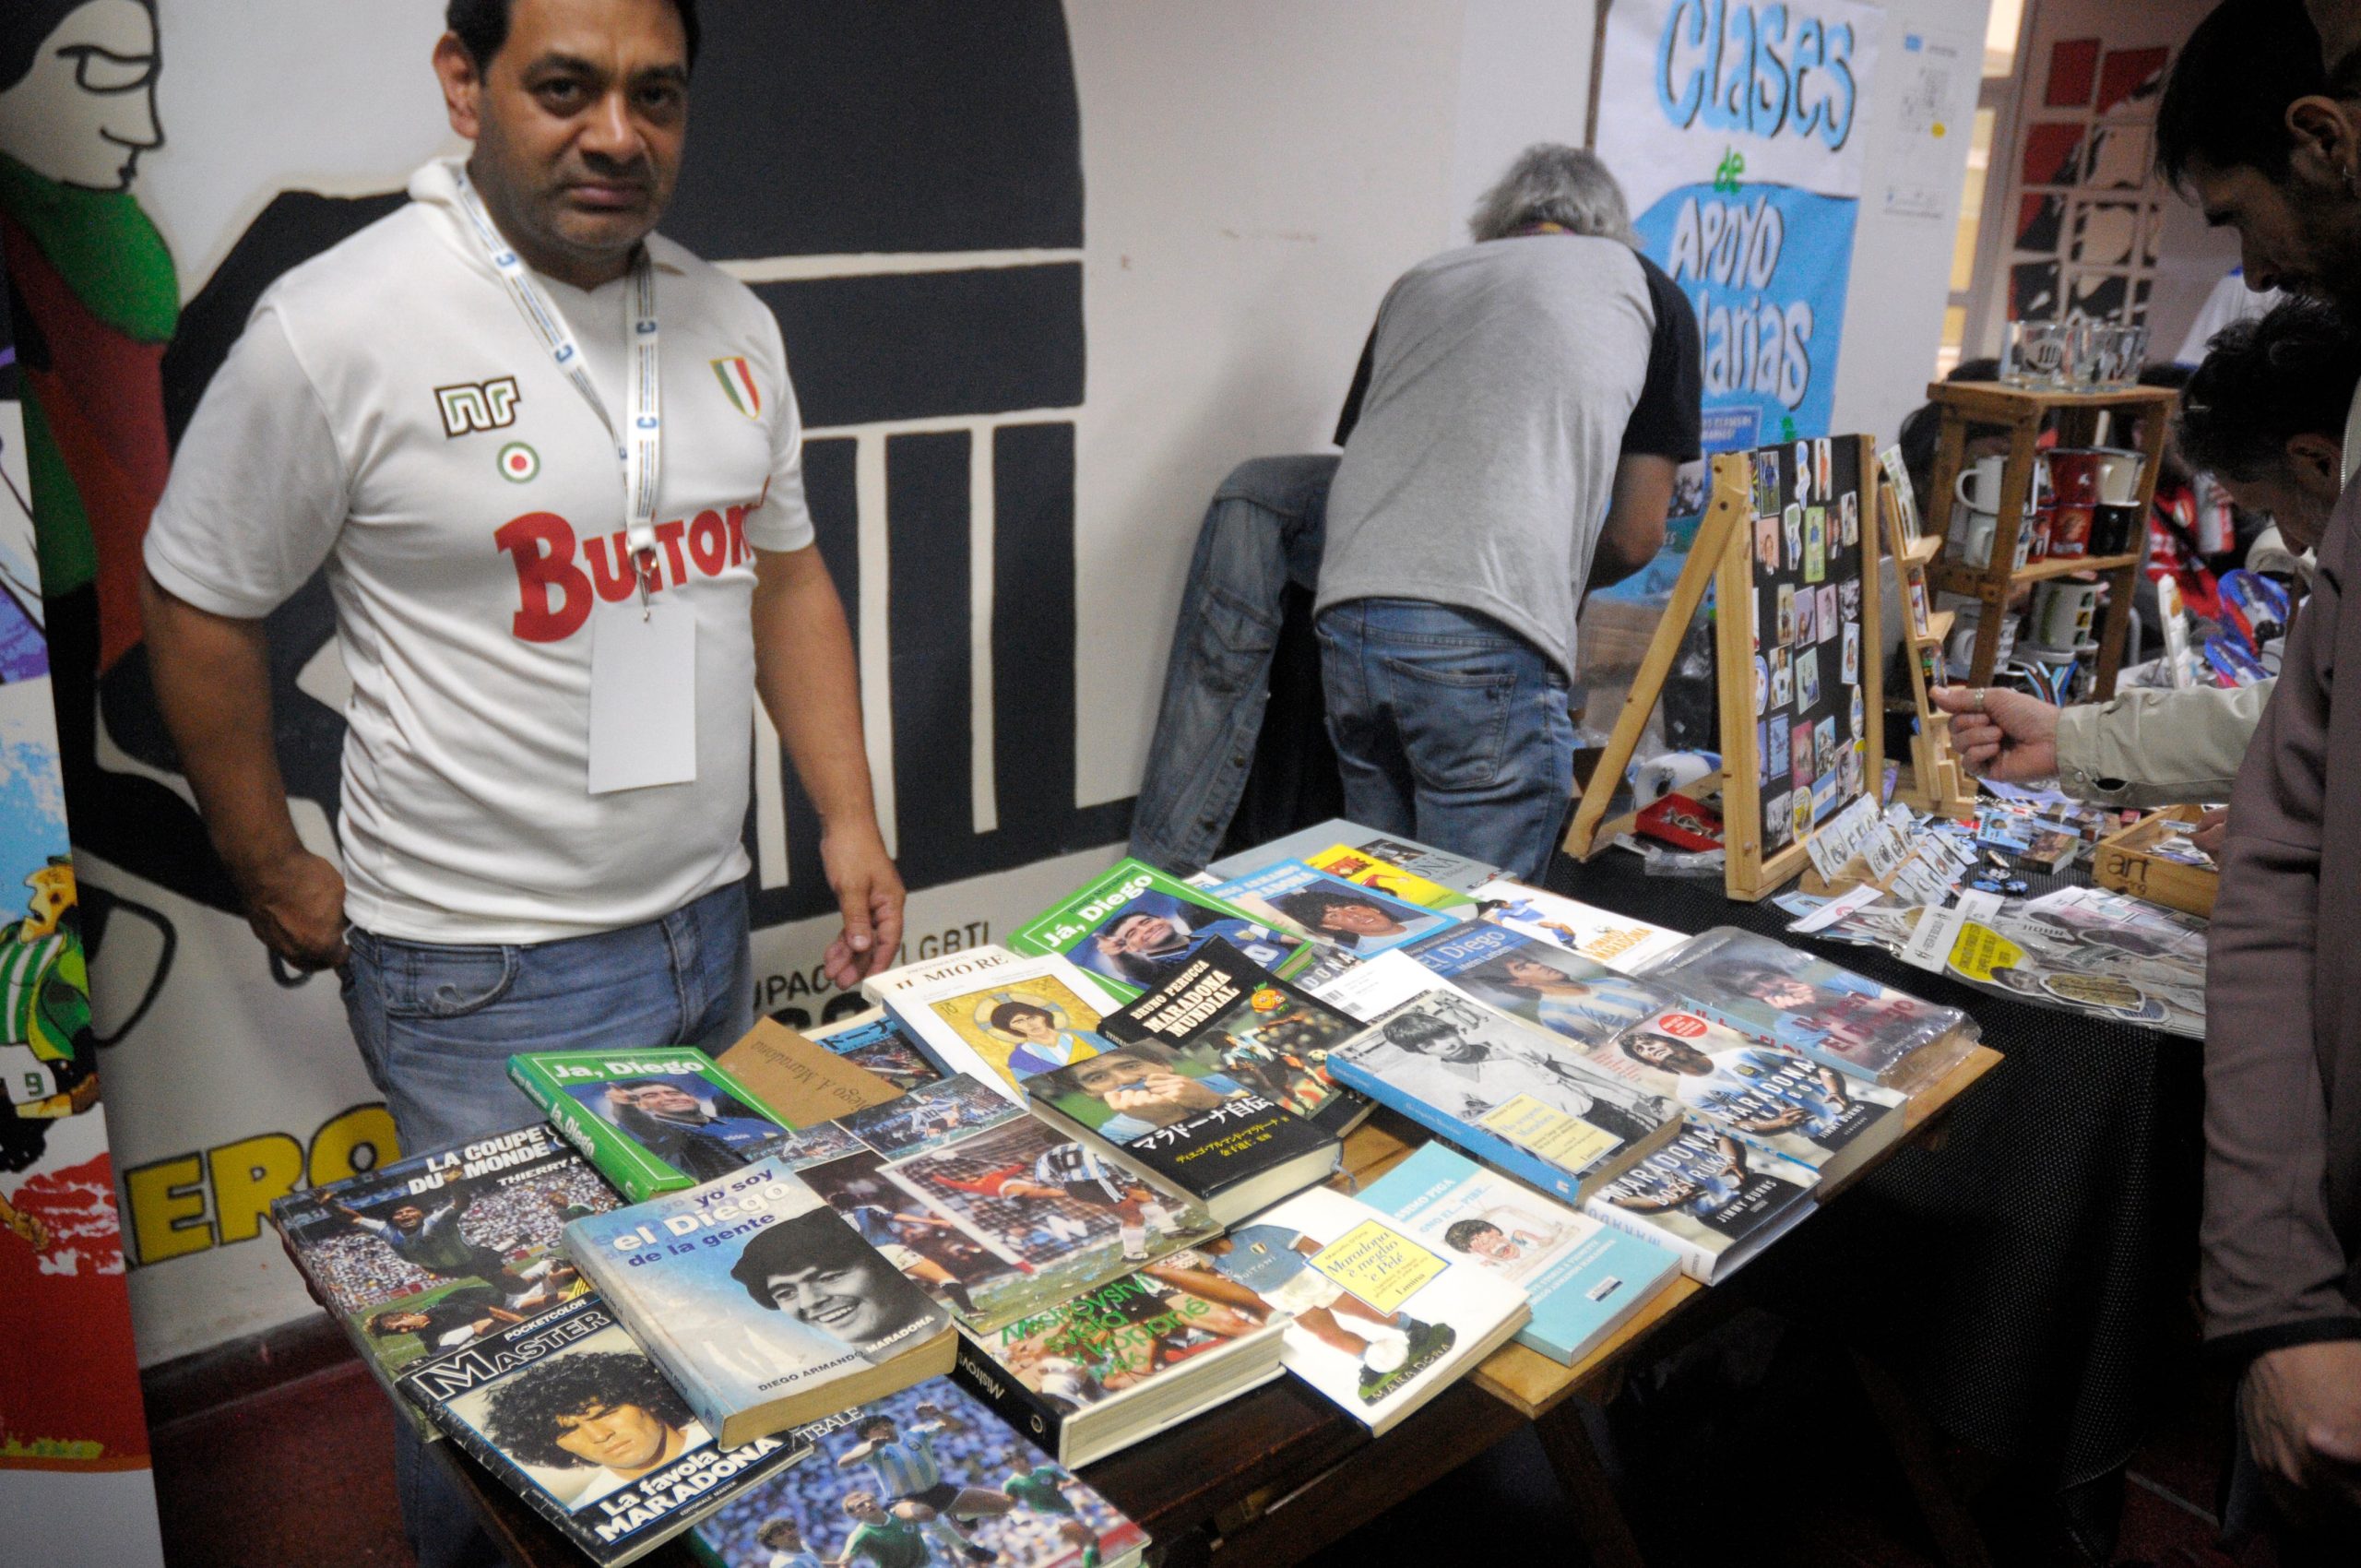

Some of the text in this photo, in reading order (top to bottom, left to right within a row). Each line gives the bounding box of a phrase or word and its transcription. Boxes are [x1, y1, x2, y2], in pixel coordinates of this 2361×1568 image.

[1655, 0, 1857, 153] Clases
[1713, 145, 1746, 196] de
[1667, 195, 1785, 293] APOYO
[1077, 874, 1153, 922] Diego
[923, 964, 973, 982] MIO
[975, 954, 1009, 970] RE
[1437, 931, 1506, 959] Diego
[1130, 959, 1211, 1020] BRUNO PERUCCA
[1143, 969, 1232, 1034] MARADONA
[1165, 984, 1241, 1038] MUNDIAL
[24, 1072, 44, 1097] 9
[604, 1060, 705, 1075] Diego
[1718, 1059, 1819, 1126] MARADONA
[1840, 1104, 1867, 1124] BURNS
[1132, 1095, 1275, 1150] マラドーナ自伝
[408, 1141, 552, 1195] DU MONDE
[425, 1152, 461, 1173] LA
[463, 1126, 545, 1161] COUPE
[496, 1158, 568, 1186] THIERRY
[1605, 1127, 1721, 1202] MARADONA
[1691, 1154, 1735, 1182] RUKA
[124, 1101, 403, 1269] ERO
[694, 1167, 774, 1208] yo soy
[1716, 1199, 1748, 1224] JIMMY
[1746, 1180, 1777, 1204] BURNS
[612, 1182, 791, 1252] el Diego
[628, 1213, 776, 1267] de la gente
[1326, 1230, 1391, 1276] Maradona
[1357, 1240, 1399, 1272] meglio
[1377, 1252, 1404, 1276] Pelé
[504, 1298, 587, 1341] POCKETCOLOR
[757, 1314, 935, 1392] DIEGO ARMANDO MARADONA
[594, 1437, 784, 1543] MARADONA
[599, 1450, 720, 1517] La favola
[680, 1480, 738, 1516] EDITORIALE MASTER
